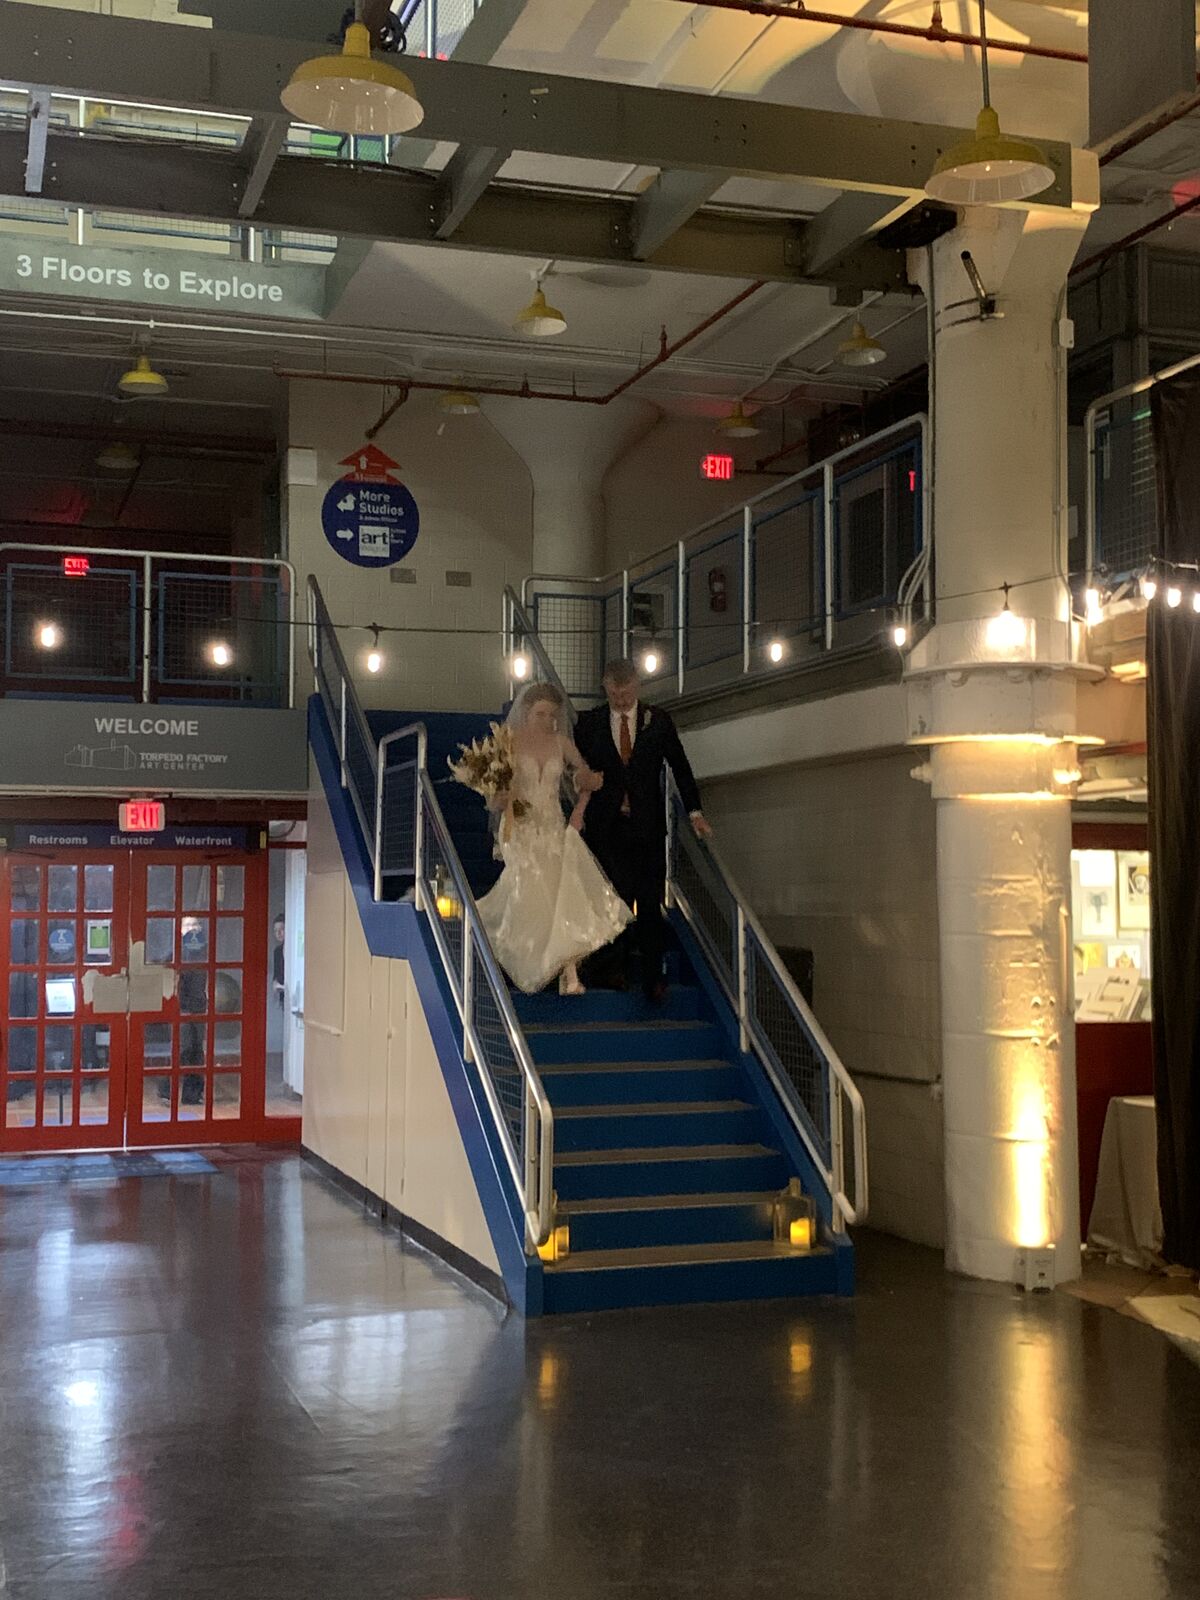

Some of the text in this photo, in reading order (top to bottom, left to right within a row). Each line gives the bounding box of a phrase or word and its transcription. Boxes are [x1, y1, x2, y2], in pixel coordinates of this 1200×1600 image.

[17, 254, 283, 301] 3 Floors to Explore
[706, 455, 733, 479] EXIT
[359, 489, 391, 502] More
[359, 502, 405, 516] Studios
[361, 532, 389, 545] art
[94, 717, 199, 736] WELCOME
[139, 752, 228, 764] TORPEDO FACTORY
[139, 761, 206, 771] ART CENTER
[125, 802, 161, 830] EXIT
[29, 834, 89, 846] Restrooms
[110, 834, 156, 846] Elevator
[175, 835, 233, 847] Waterfront
